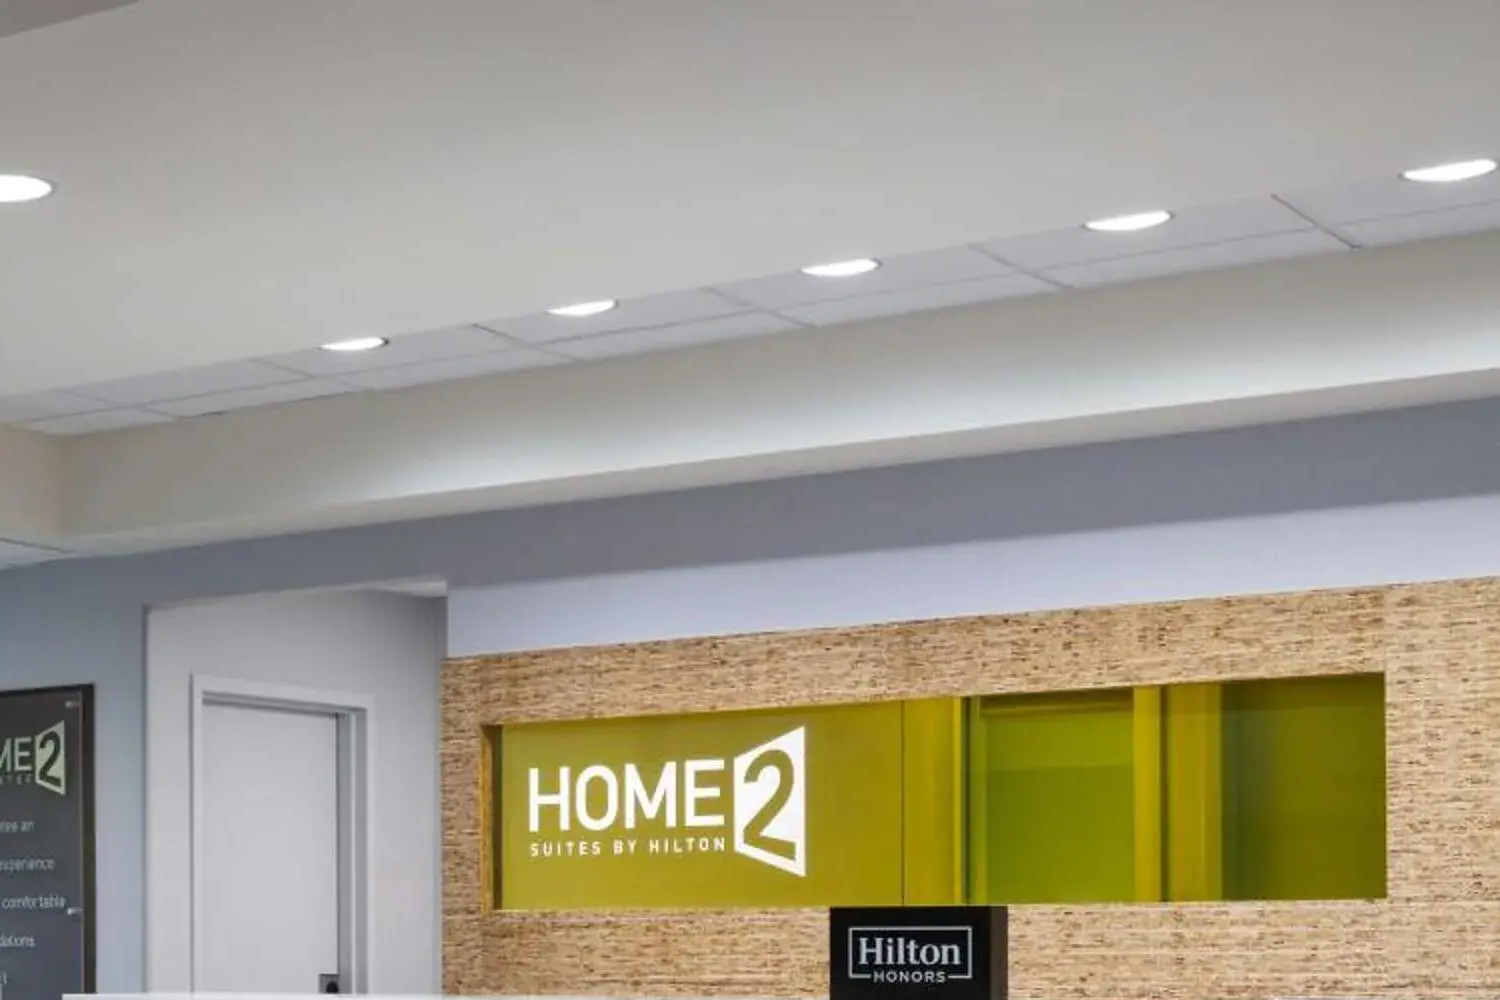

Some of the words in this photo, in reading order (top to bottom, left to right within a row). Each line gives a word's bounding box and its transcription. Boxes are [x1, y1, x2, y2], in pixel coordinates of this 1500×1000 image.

[20, 820, 35, 833] an
[530, 841, 601, 858] SUITES
[613, 839, 637, 856] BY
[649, 836, 725, 854] HILTON
[1, 894, 67, 909] comfortable
[858, 937, 961, 966] Hilton
[873, 970, 946, 983] HONORS
